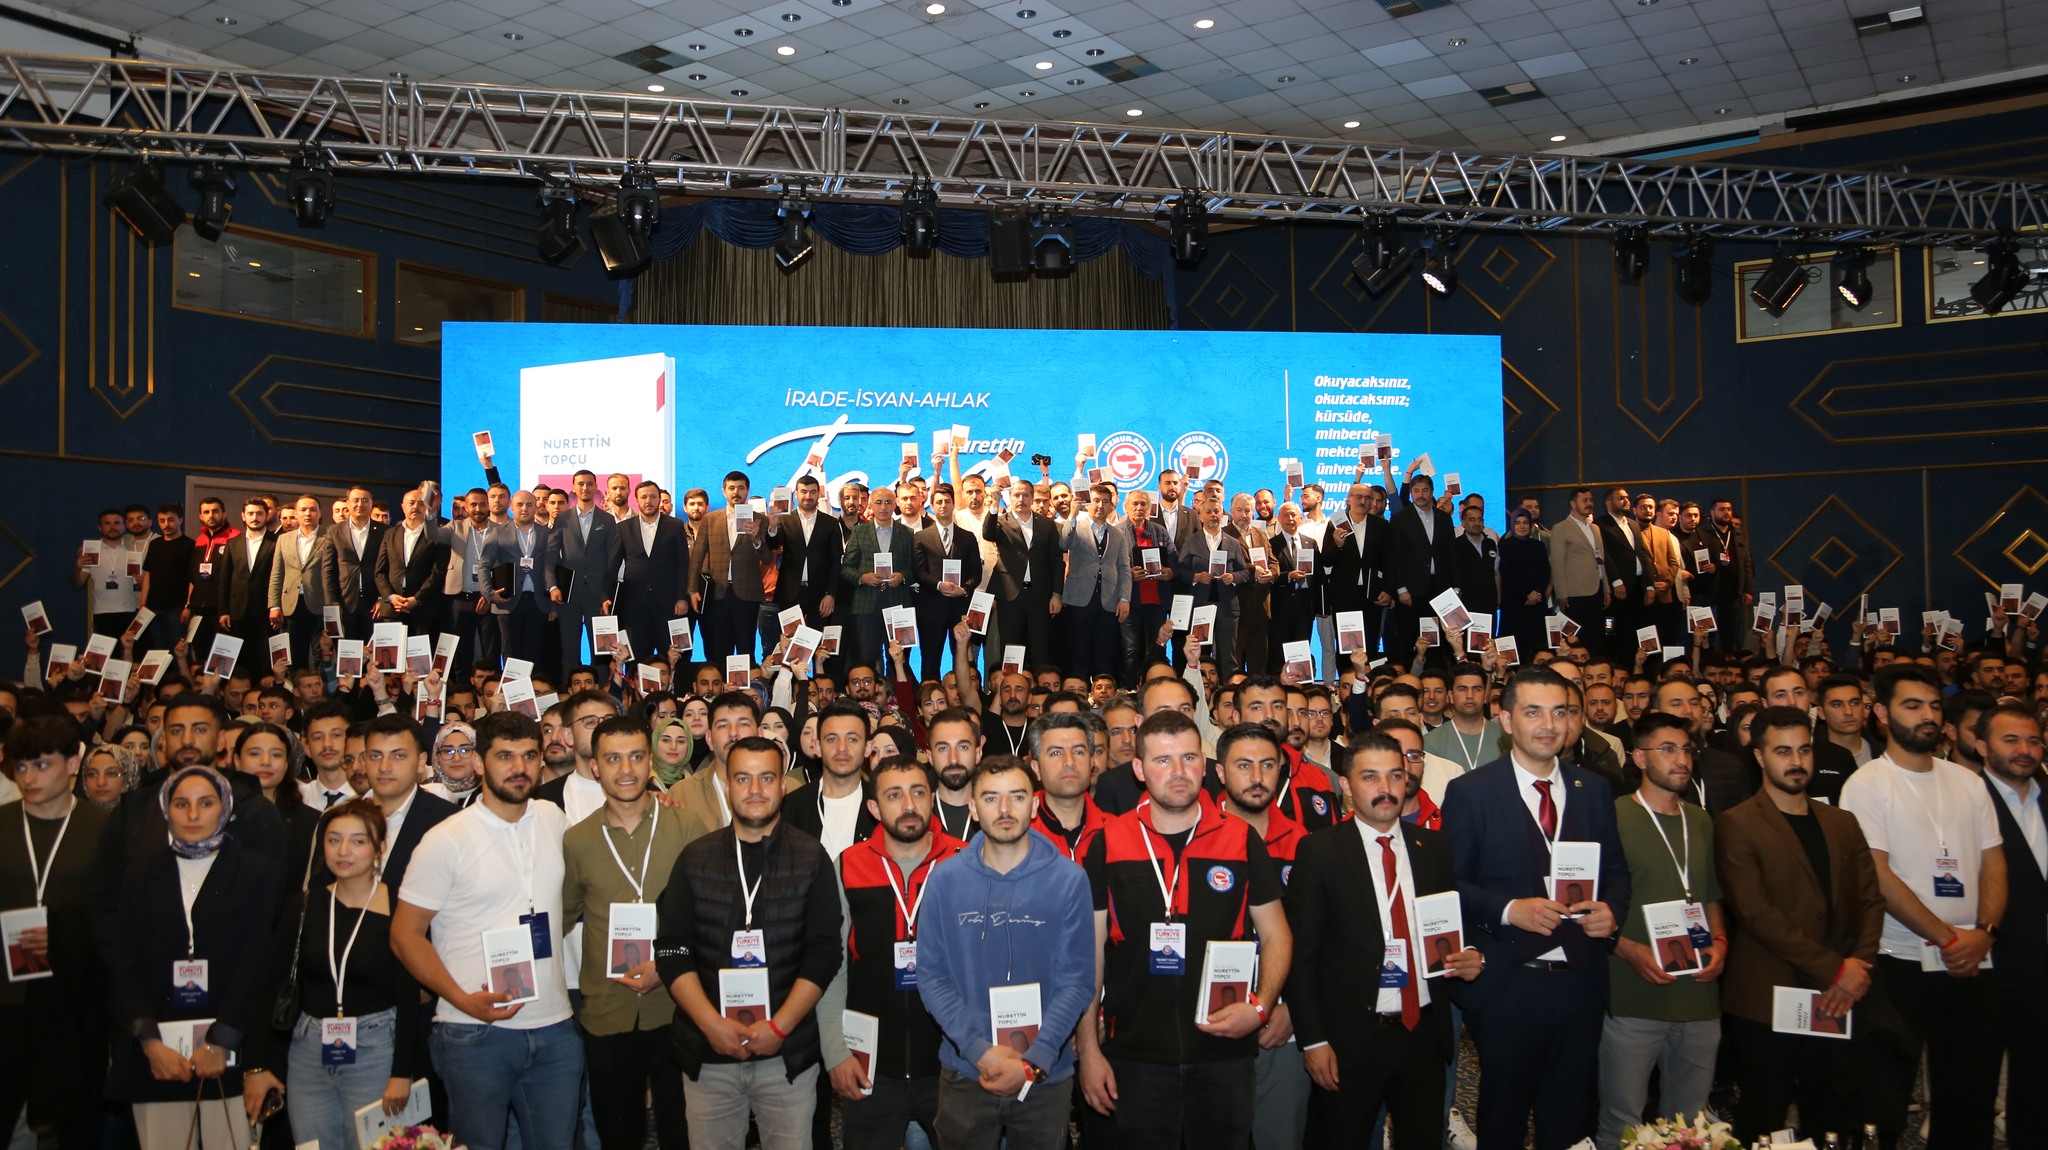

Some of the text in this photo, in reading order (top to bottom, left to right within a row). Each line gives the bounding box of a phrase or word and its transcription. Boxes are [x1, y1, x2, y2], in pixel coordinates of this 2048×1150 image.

[1314, 375, 1412, 390] Okuyacaksınız,
[785, 388, 991, 408] İRADE-İSYAN-AHLAK
[1314, 392, 1411, 407] okutacaksınız;
[1314, 410, 1373, 424] kürsüde,
[543, 433, 611, 449] NURETTİN
[957, 437, 1025, 454] urettin
[543, 454, 587, 467] TOPÇU
